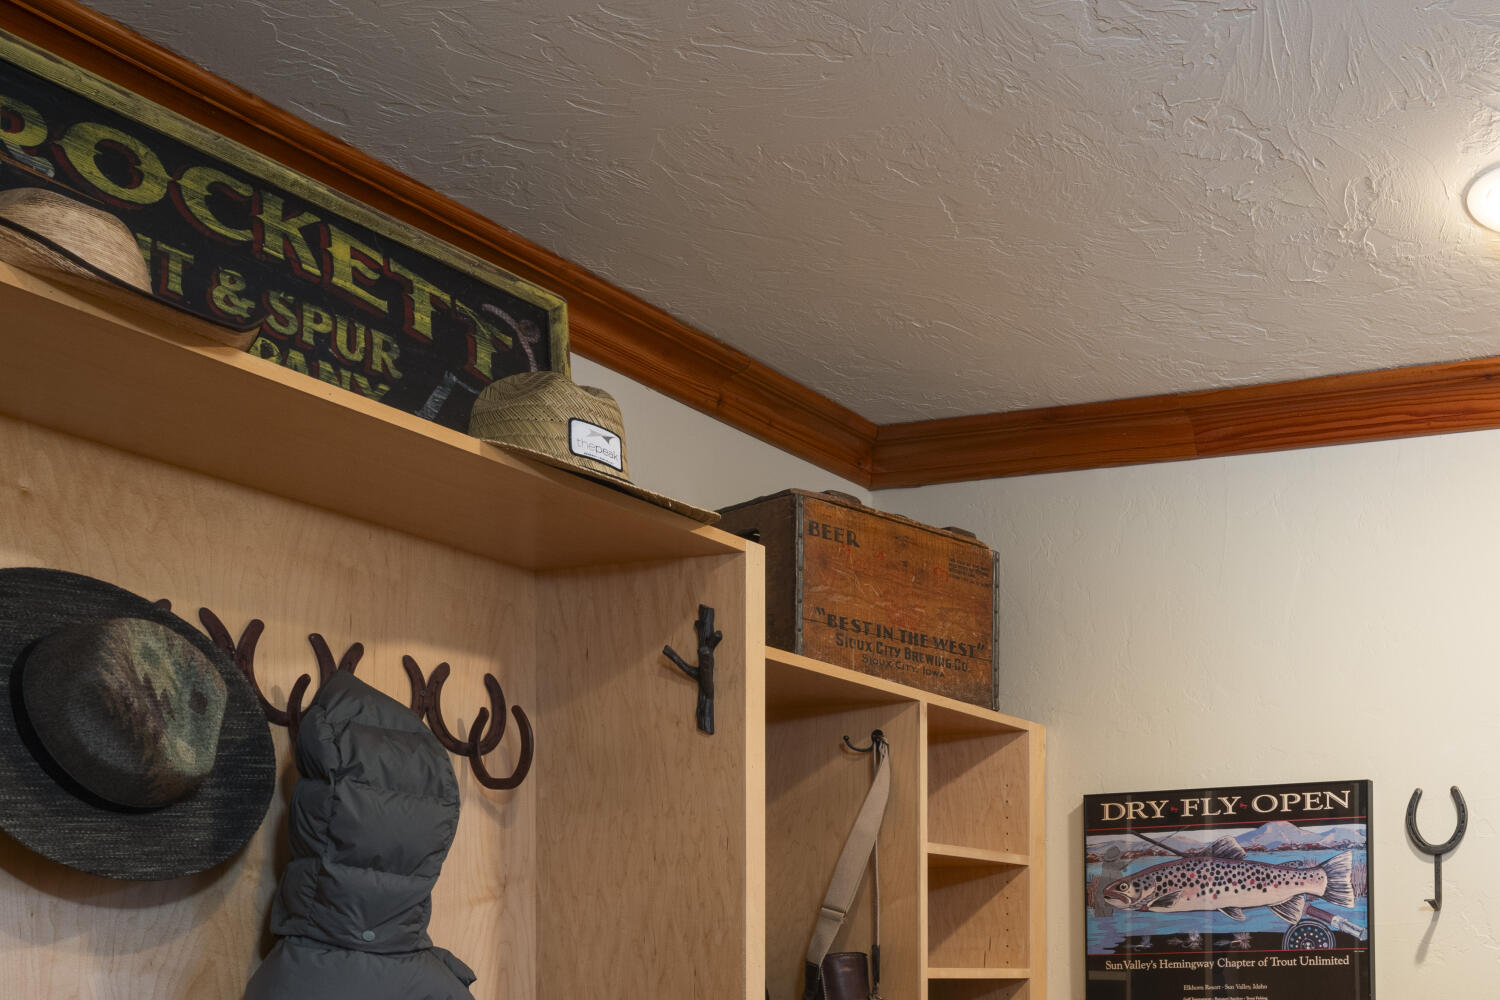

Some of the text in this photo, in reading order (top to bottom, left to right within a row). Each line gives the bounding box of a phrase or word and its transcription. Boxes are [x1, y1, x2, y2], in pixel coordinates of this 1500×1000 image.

[265, 290, 402, 379] SPUR
[808, 519, 861, 548] BEER
[876, 623, 894, 641] IN
[897, 629, 929, 649] THE
[1100, 790, 1351, 821] DRY FLY OPEN
[1105, 954, 1350, 971] Sun Valley's Hemingway Chapter of Trout Unlimited
